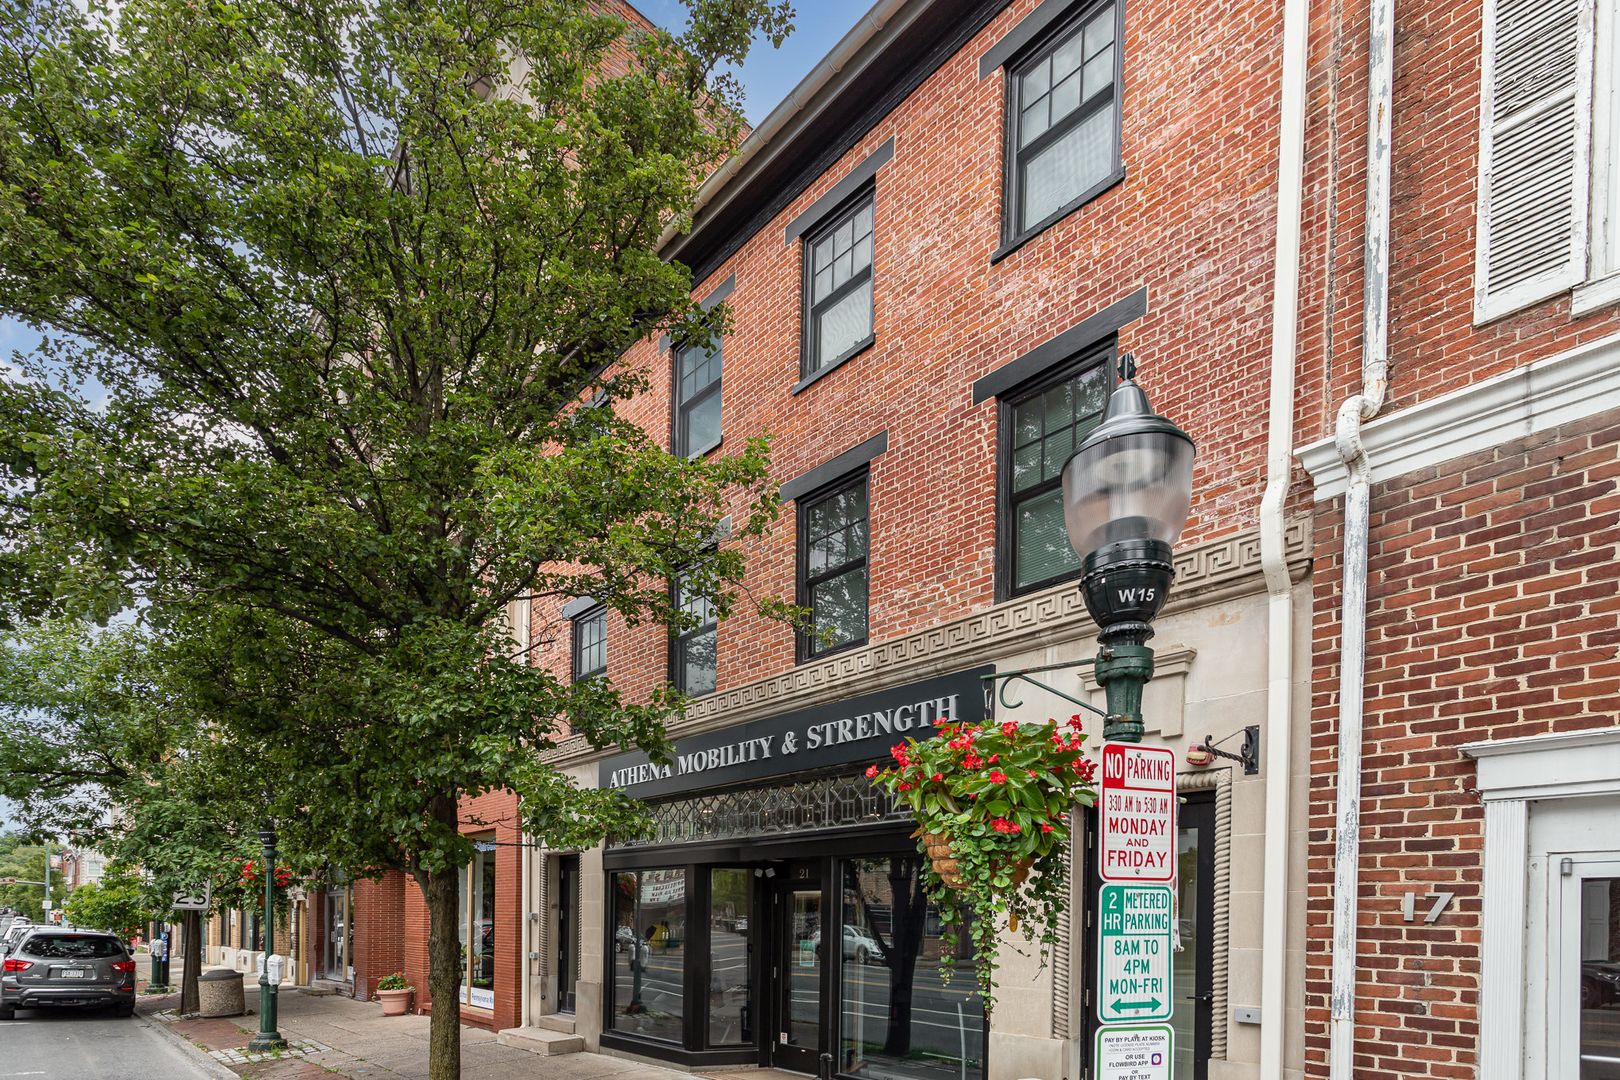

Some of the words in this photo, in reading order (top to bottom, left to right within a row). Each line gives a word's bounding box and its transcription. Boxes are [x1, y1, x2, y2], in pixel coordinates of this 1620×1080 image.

[609, 762, 672, 789] ATHENA
[677, 735, 775, 776] MOBILITY
[781, 731, 798, 755] &
[806, 694, 960, 749] STRENGTH
[1105, 753, 1123, 779] NO
[1127, 757, 1170, 781] PARKING
[1109, 795, 1122, 812] 3:30
[1125, 796, 1133, 812] AM
[1136, 797, 1141, 813] to
[1144, 797, 1157, 814] 5:30
[1160, 798, 1168, 814] AM
[1109, 817, 1167, 836] MONDAY
[1126, 838, 1149, 847] AND
[1108, 850, 1167, 868] FRIDAY
[1109, 892, 1118, 909] 2
[1125, 892, 1168, 909] METERED
[1403, 892, 1455, 923] 17
[1104, 913, 1121, 930] HR
[1125, 913, 1168, 930] PARKING
[1114, 940, 1140, 956] 8AM
[1144, 939, 1159, 955] TO
[1123, 959, 1150, 974] 4PM
[1110, 977, 1163, 995] MON-FRI
